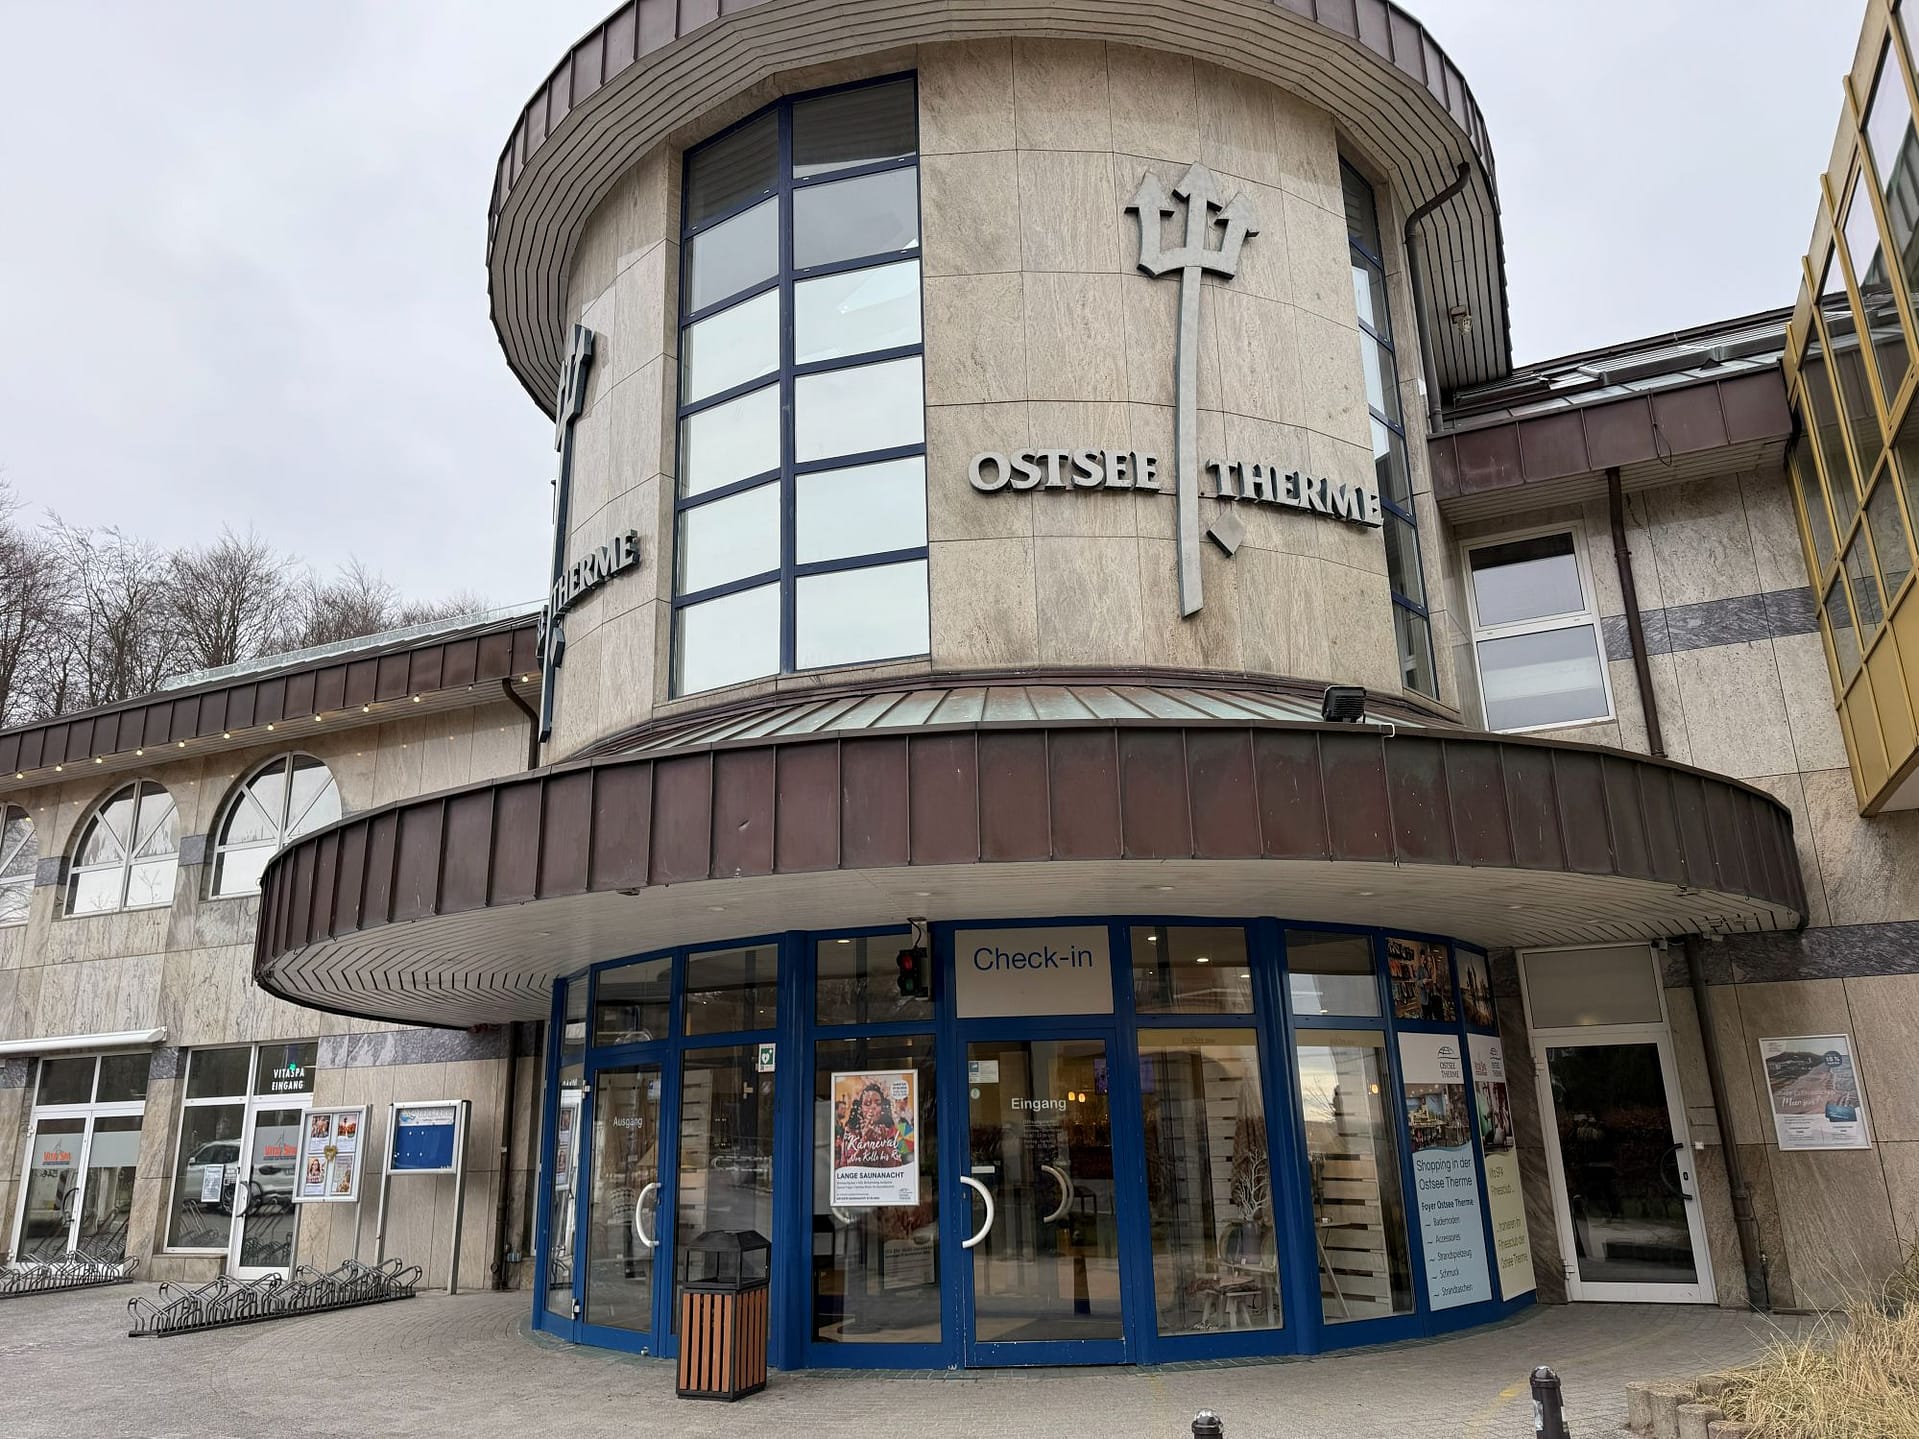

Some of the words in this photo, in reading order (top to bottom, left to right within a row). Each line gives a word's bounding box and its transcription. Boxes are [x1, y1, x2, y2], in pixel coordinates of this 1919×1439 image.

[968, 448, 1161, 494] OSTSEE
[1205, 458, 1383, 528] THERME
[551, 529, 640, 619] THERME
[973, 945, 1093, 971] Check-in
[273, 1068, 305, 1079] VITASPA
[271, 1080, 304, 1091] EINGANG
[1011, 1097, 1067, 1112] Eingang
[612, 1116, 643, 1128] Ausgang
[847, 1130, 900, 1151] Karneval
[1416, 1159, 1452, 1174] Shopping
[1459, 1156, 1472, 1169] der
[860, 1171, 905, 1179] SAUNANACHT
[1419, 1178, 1445, 1191] Ostsee
[1445, 1176, 1473, 1188] Therme
[1421, 1202, 1437, 1212] Foyer
[1436, 1200, 1454, 1210] Ostsee
[1454, 1198, 1474, 1207] Therme
